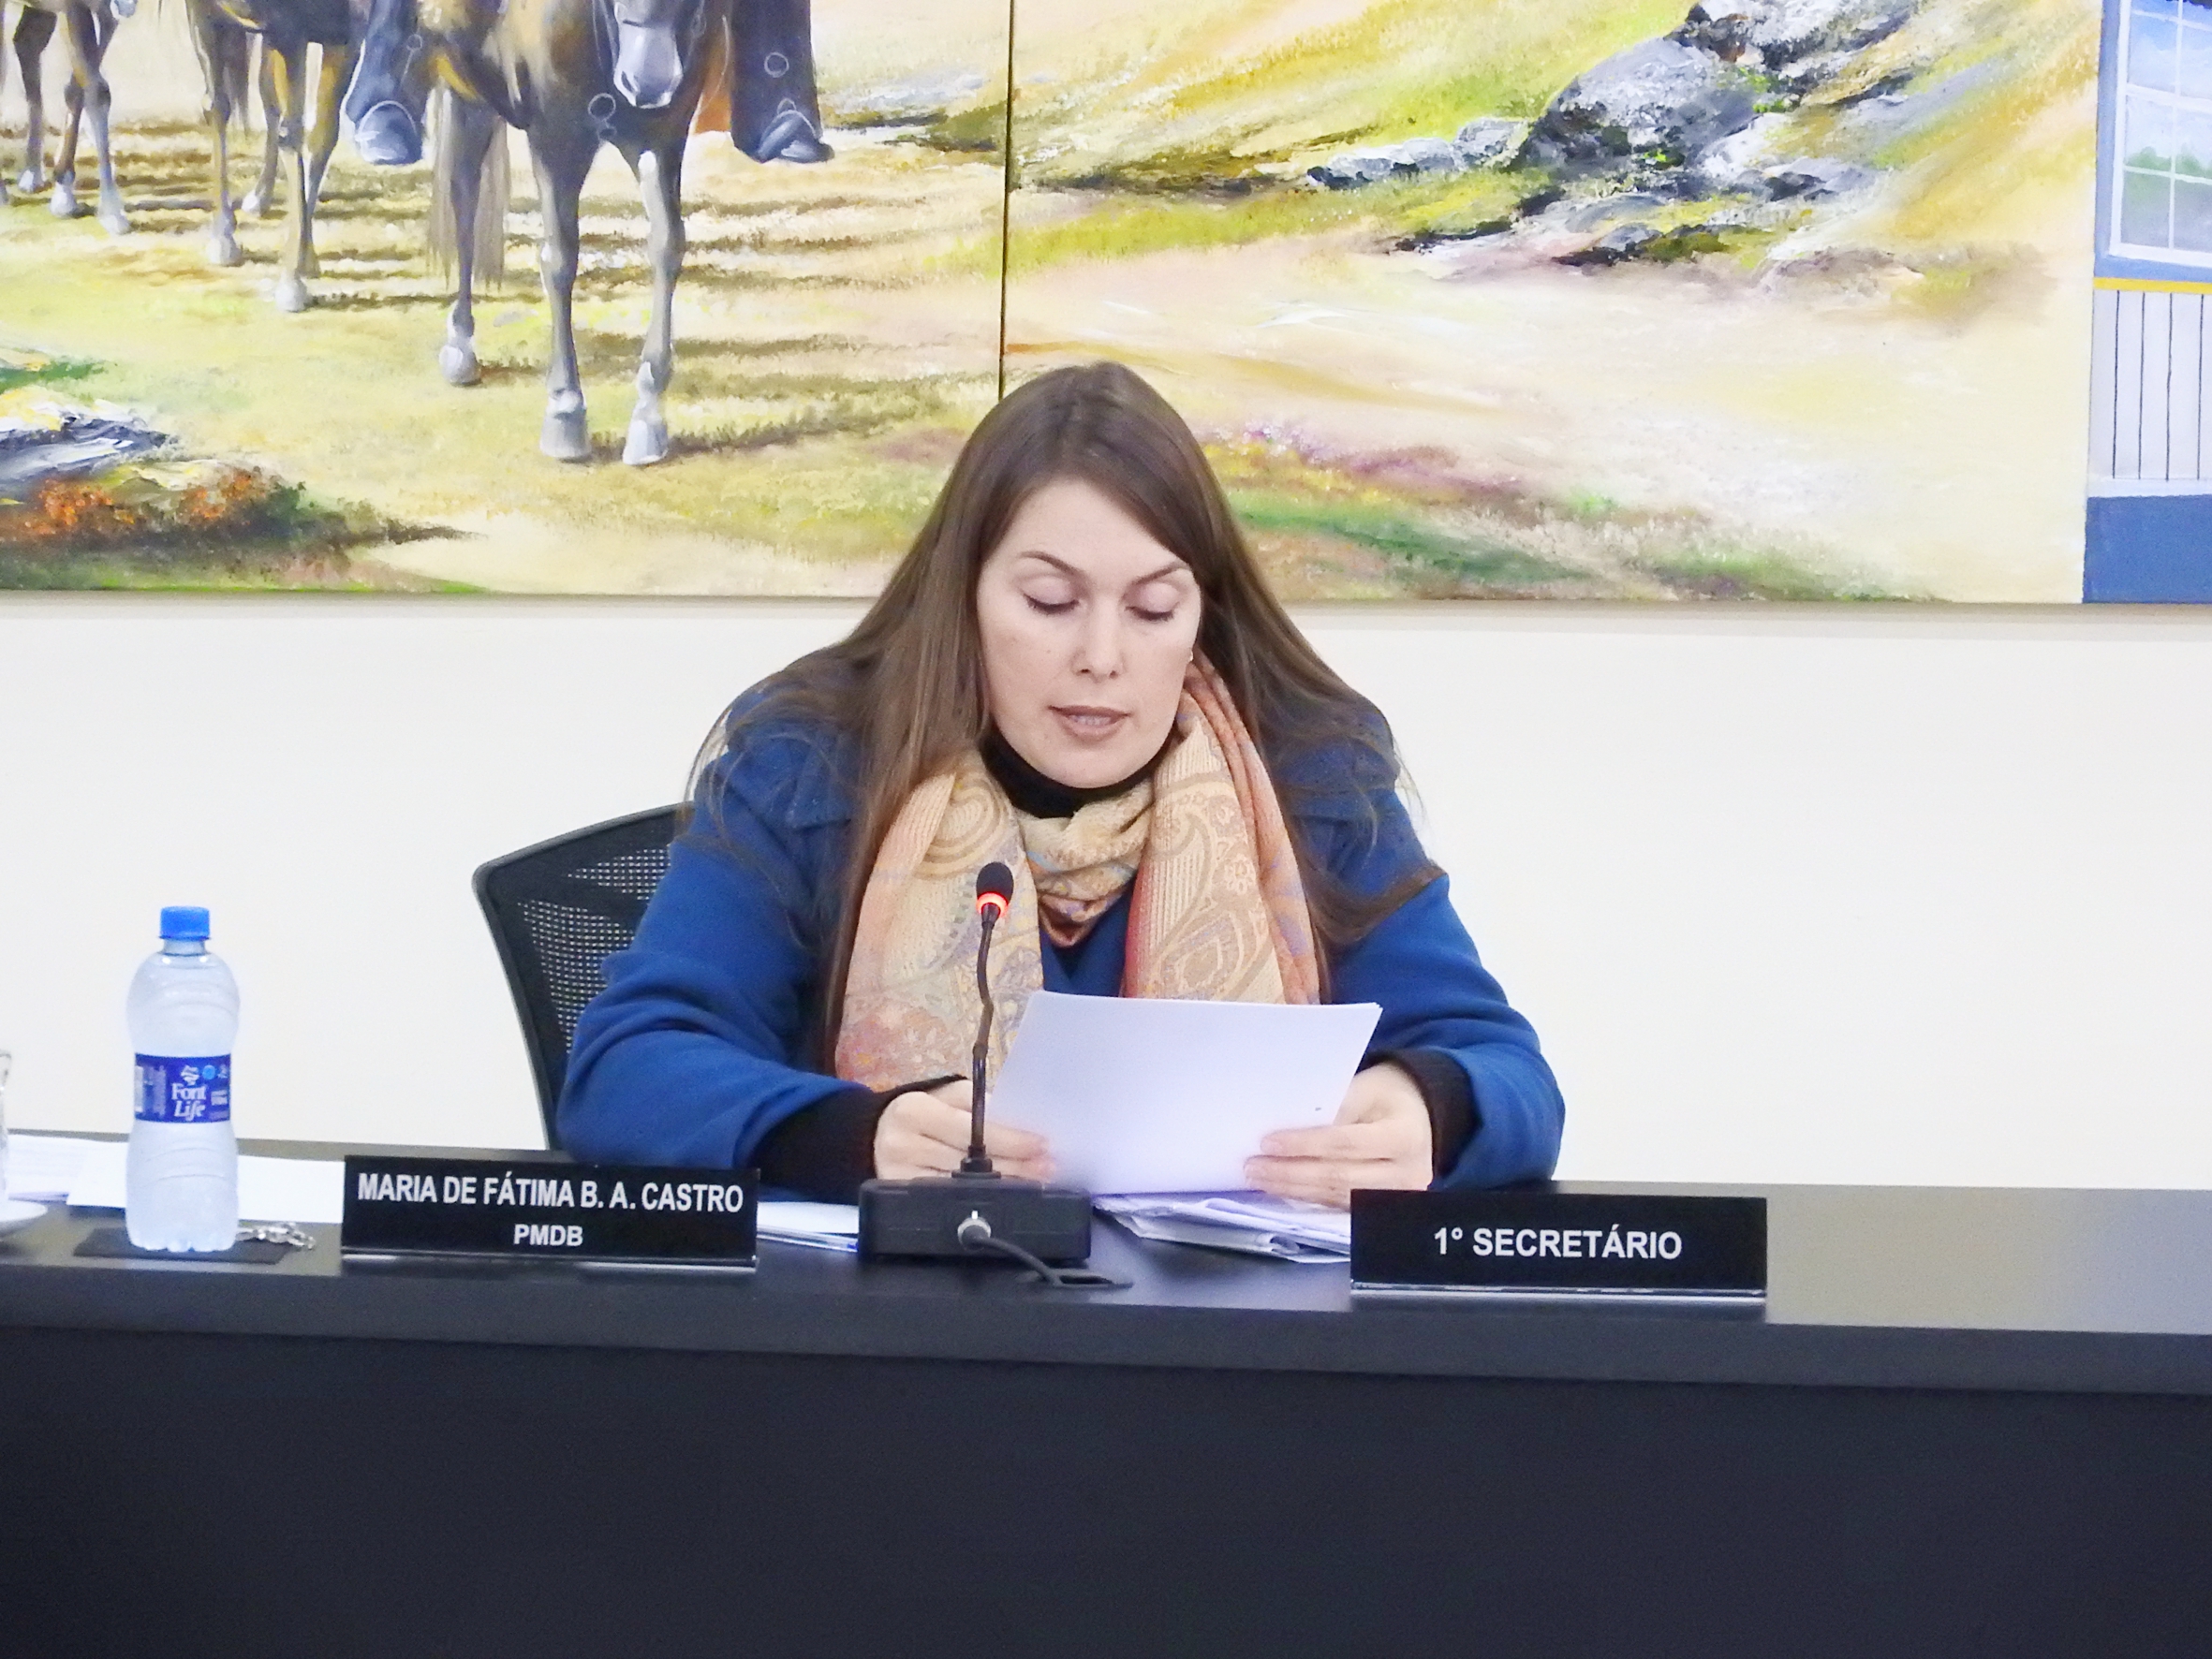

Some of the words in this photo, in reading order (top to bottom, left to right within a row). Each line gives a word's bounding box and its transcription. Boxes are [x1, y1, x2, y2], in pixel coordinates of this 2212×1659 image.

[174, 1100, 206, 1122] Life
[358, 1173, 437, 1203] MARIA
[443, 1176, 477, 1205] DE
[483, 1171, 575, 1208] FÁTIMA
[581, 1181, 604, 1209] B.
[609, 1182, 636, 1210] A.
[641, 1182, 744, 1213] CASTRO
[513, 1224, 583, 1247] PMDB
[1472, 1224, 1683, 1260] SECRETÁRIO
